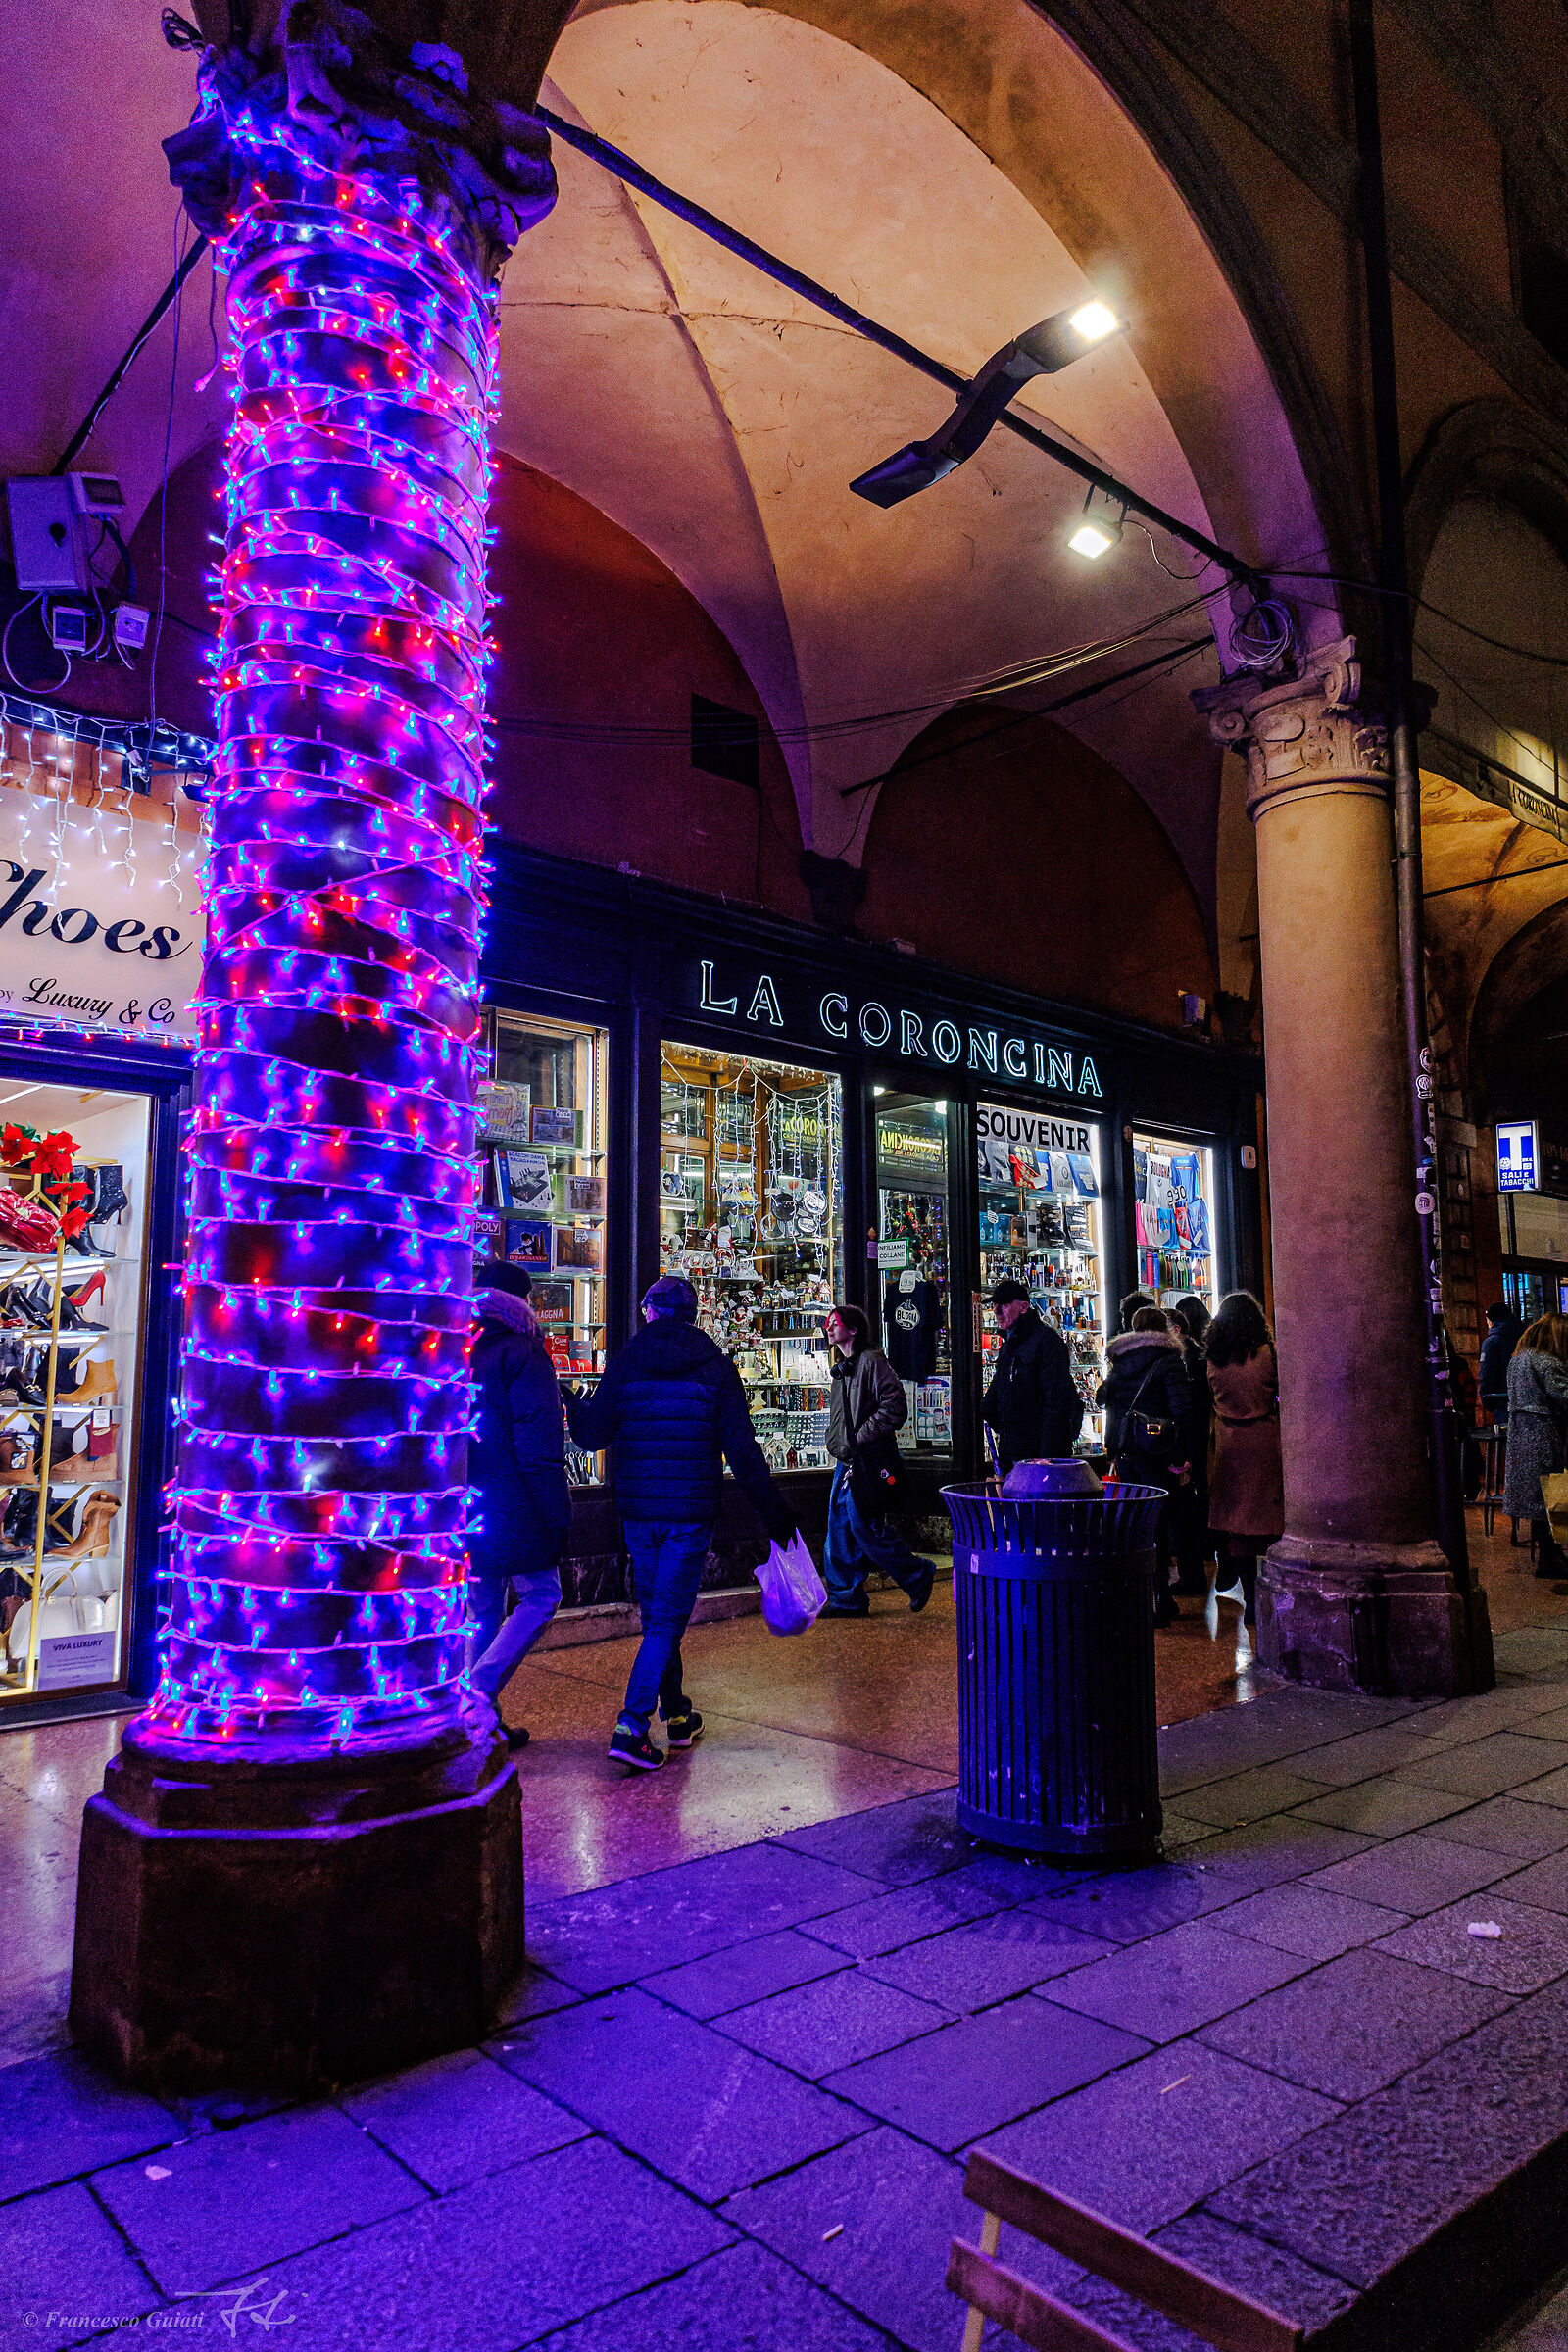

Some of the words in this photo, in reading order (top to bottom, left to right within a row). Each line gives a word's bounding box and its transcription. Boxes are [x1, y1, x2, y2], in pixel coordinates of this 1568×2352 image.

[22, 977, 114, 1020] Luxury
[118, 999, 143, 1025] &
[148, 997, 175, 1024] Co
[700, 960, 784, 1026] LA
[820, 992, 1102, 1097] CORONCINA
[977, 1109, 1091, 1152] SOUVENIR
[1501, 1171, 1522, 1180] SALI
[1500, 1178, 1534, 1187] TABACCHI
[473, 1221, 499, 1233] POLY
[53, 1643, 73, 1652] VIVA
[73, 1639, 103, 1650] LUXURY
